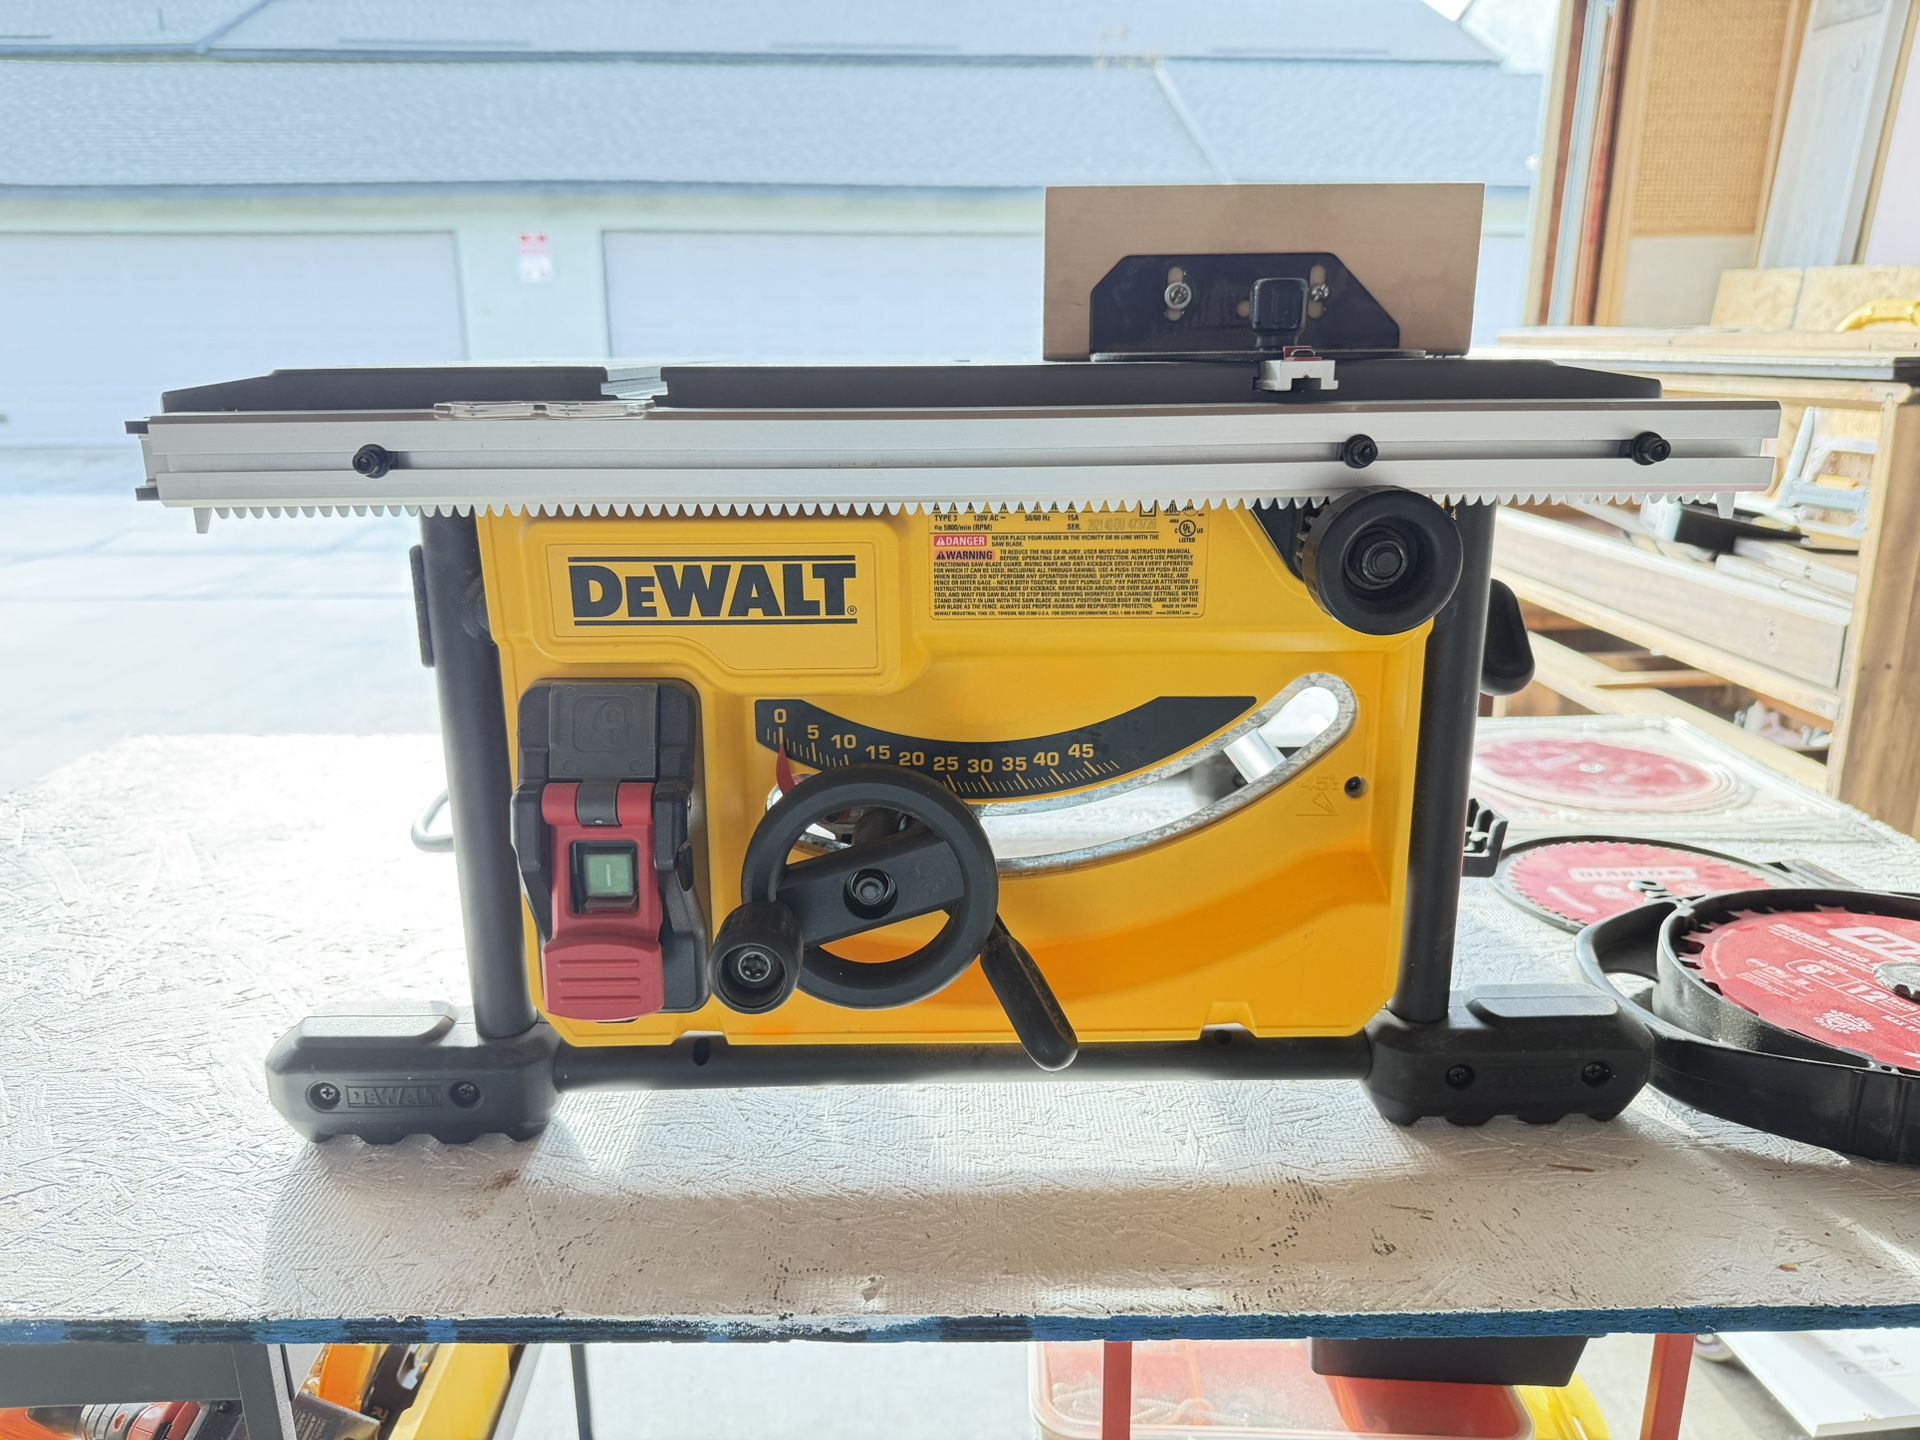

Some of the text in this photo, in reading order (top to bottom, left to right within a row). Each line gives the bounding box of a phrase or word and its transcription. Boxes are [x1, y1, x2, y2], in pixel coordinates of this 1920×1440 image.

[946, 536, 985, 546] DANGER
[946, 550, 993, 560] WARNING
[773, 709, 1094, 773] 0 5 10 15 20 25 30 35 40 45
